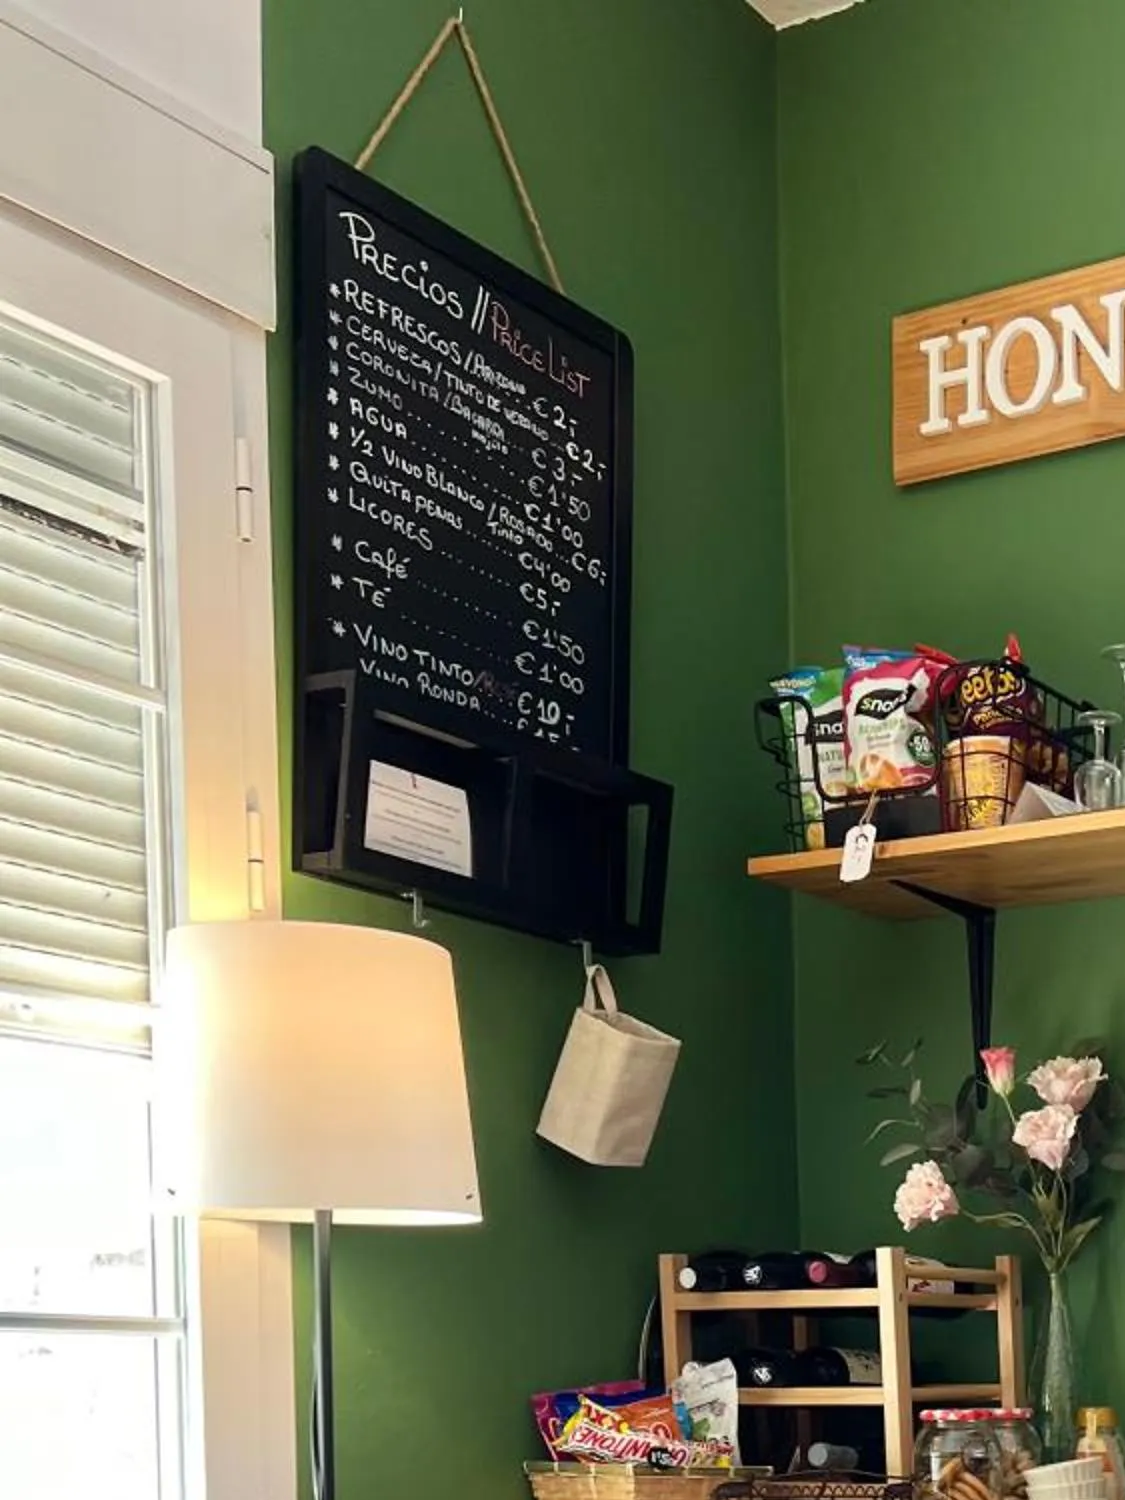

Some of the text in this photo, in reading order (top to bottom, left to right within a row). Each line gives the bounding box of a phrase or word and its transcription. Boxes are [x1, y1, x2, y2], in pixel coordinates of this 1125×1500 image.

[348, 366, 402, 411] ZUMO
[487, 393, 501, 412] DE
[350, 397, 407, 439] AGUA
[349, 487, 432, 550] LICORES
[355, 541, 411, 579] Café
[353, 623, 408, 661] VINO
[417, 671, 480, 712] RONDA
